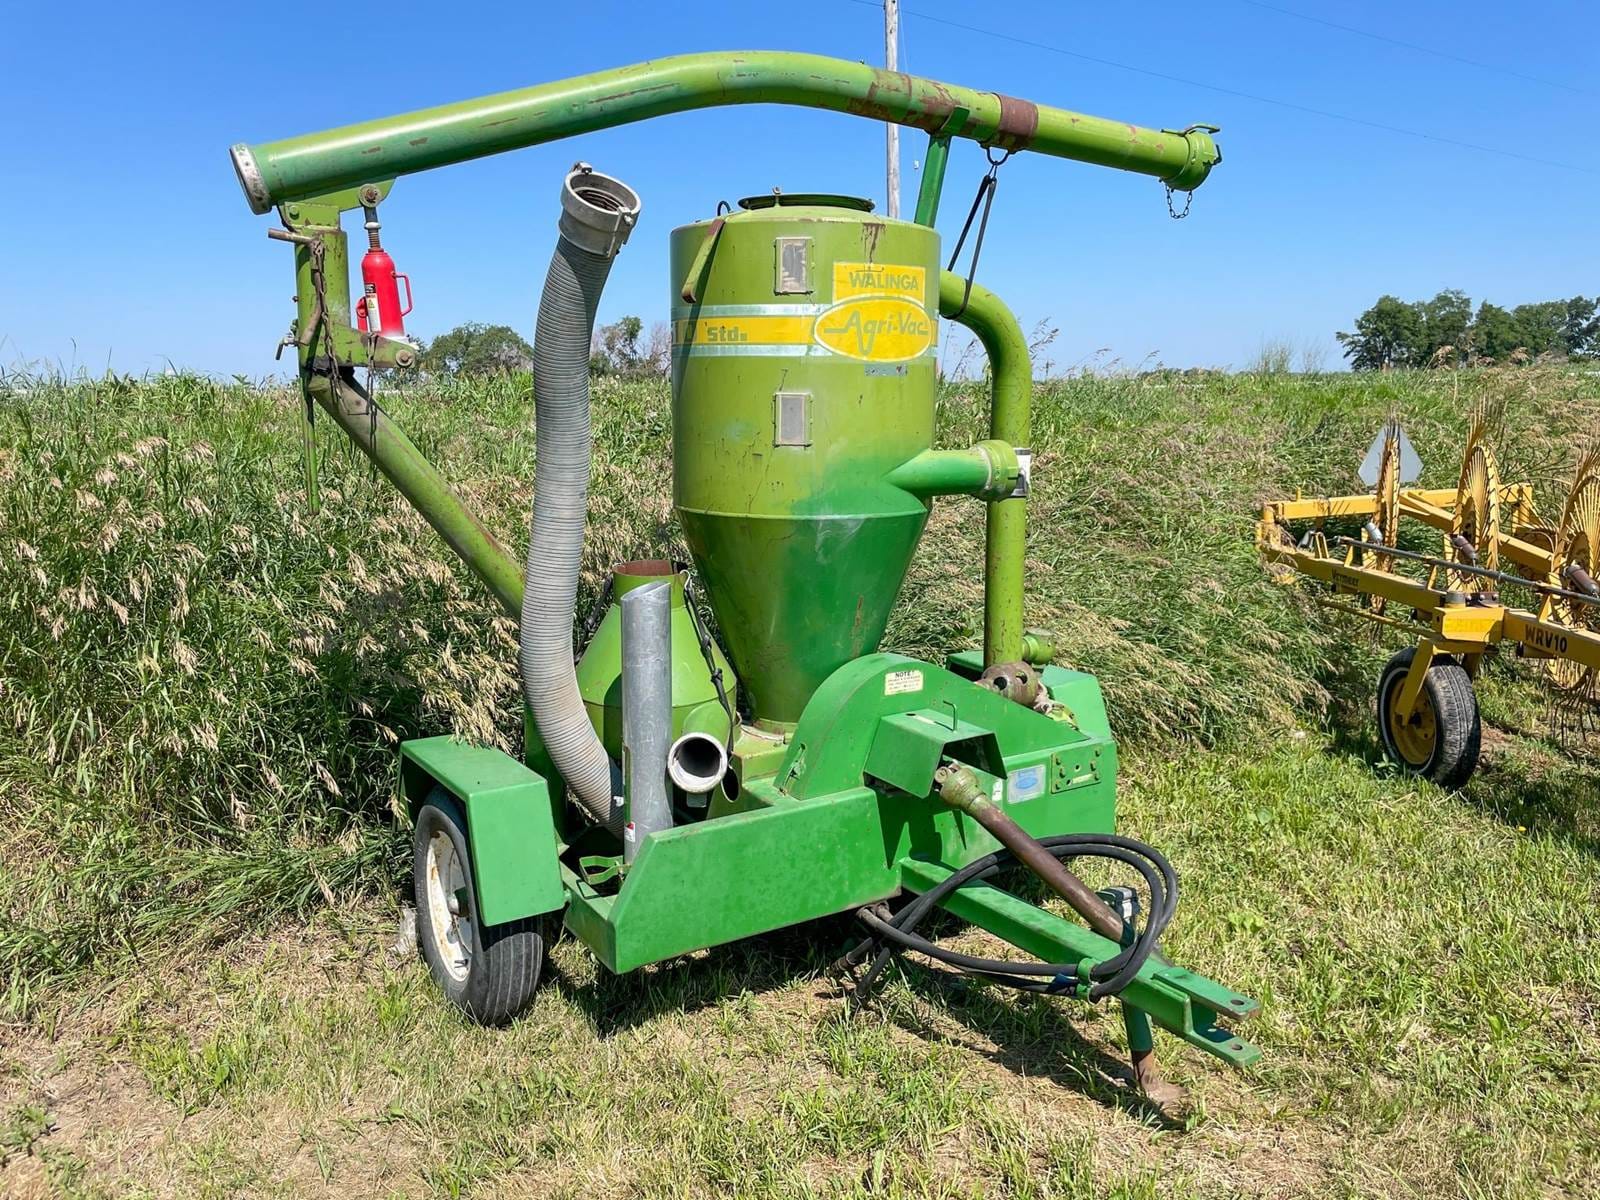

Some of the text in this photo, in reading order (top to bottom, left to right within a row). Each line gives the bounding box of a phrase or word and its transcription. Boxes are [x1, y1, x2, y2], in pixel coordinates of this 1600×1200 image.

[849, 272, 919, 290] WALINGA
[707, 325, 748, 342] Std.
[1525, 624, 1568, 653] WRV10
